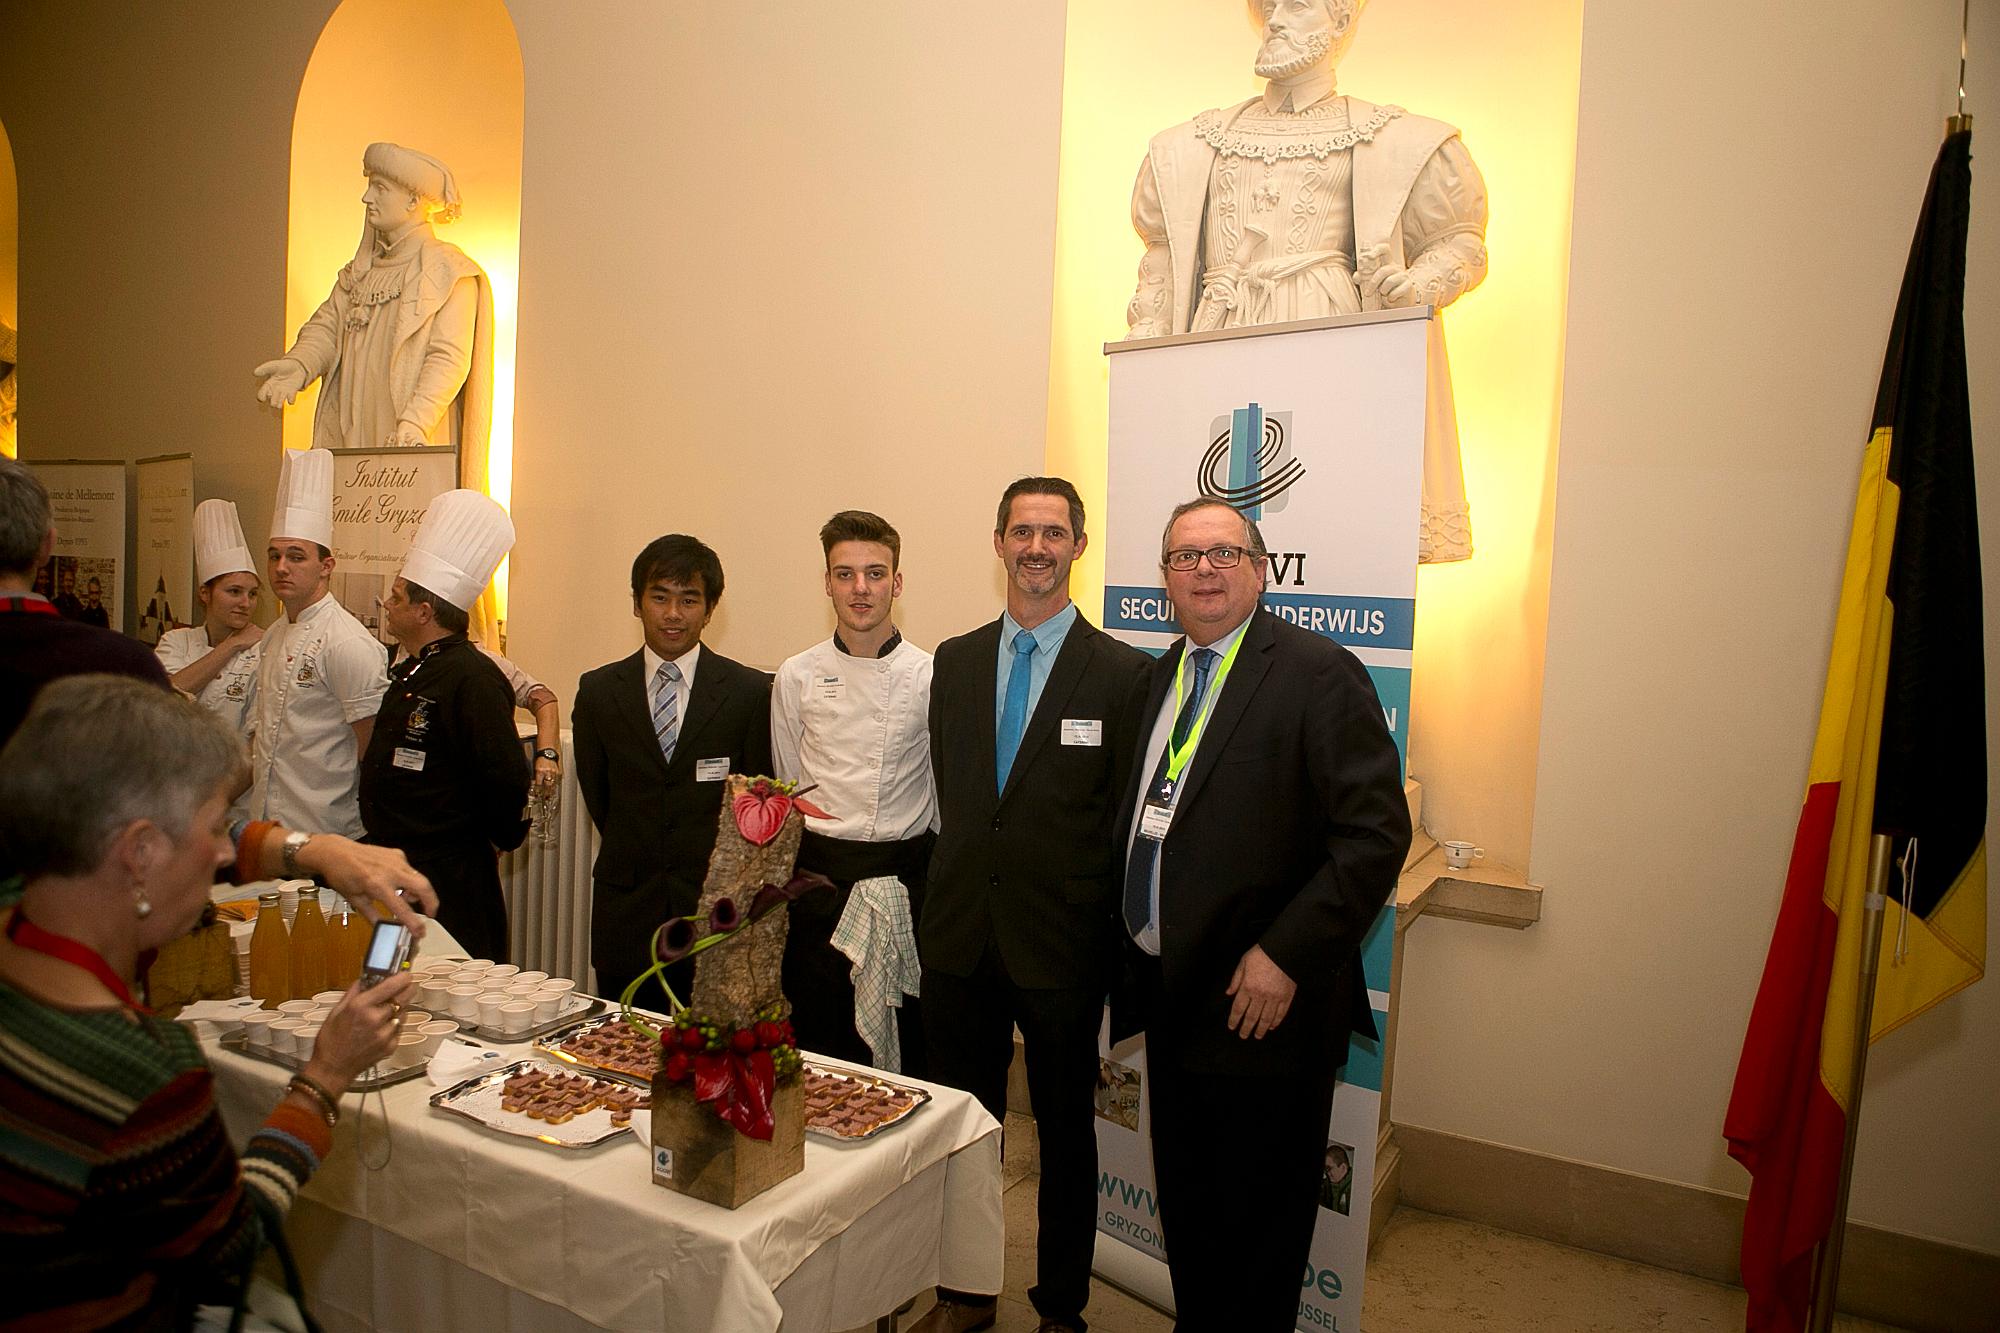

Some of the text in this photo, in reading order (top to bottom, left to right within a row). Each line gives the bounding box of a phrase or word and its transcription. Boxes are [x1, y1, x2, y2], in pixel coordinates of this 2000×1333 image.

[345, 459, 419, 488] Institut
[49, 488, 64, 500] aine
[76, 488, 115, 500] Mellemont
[1267, 553, 1306, 586] VI
[1120, 597, 1385, 636] SECU DERWIJS
[1105, 1211, 1164, 1251] GRYZON
